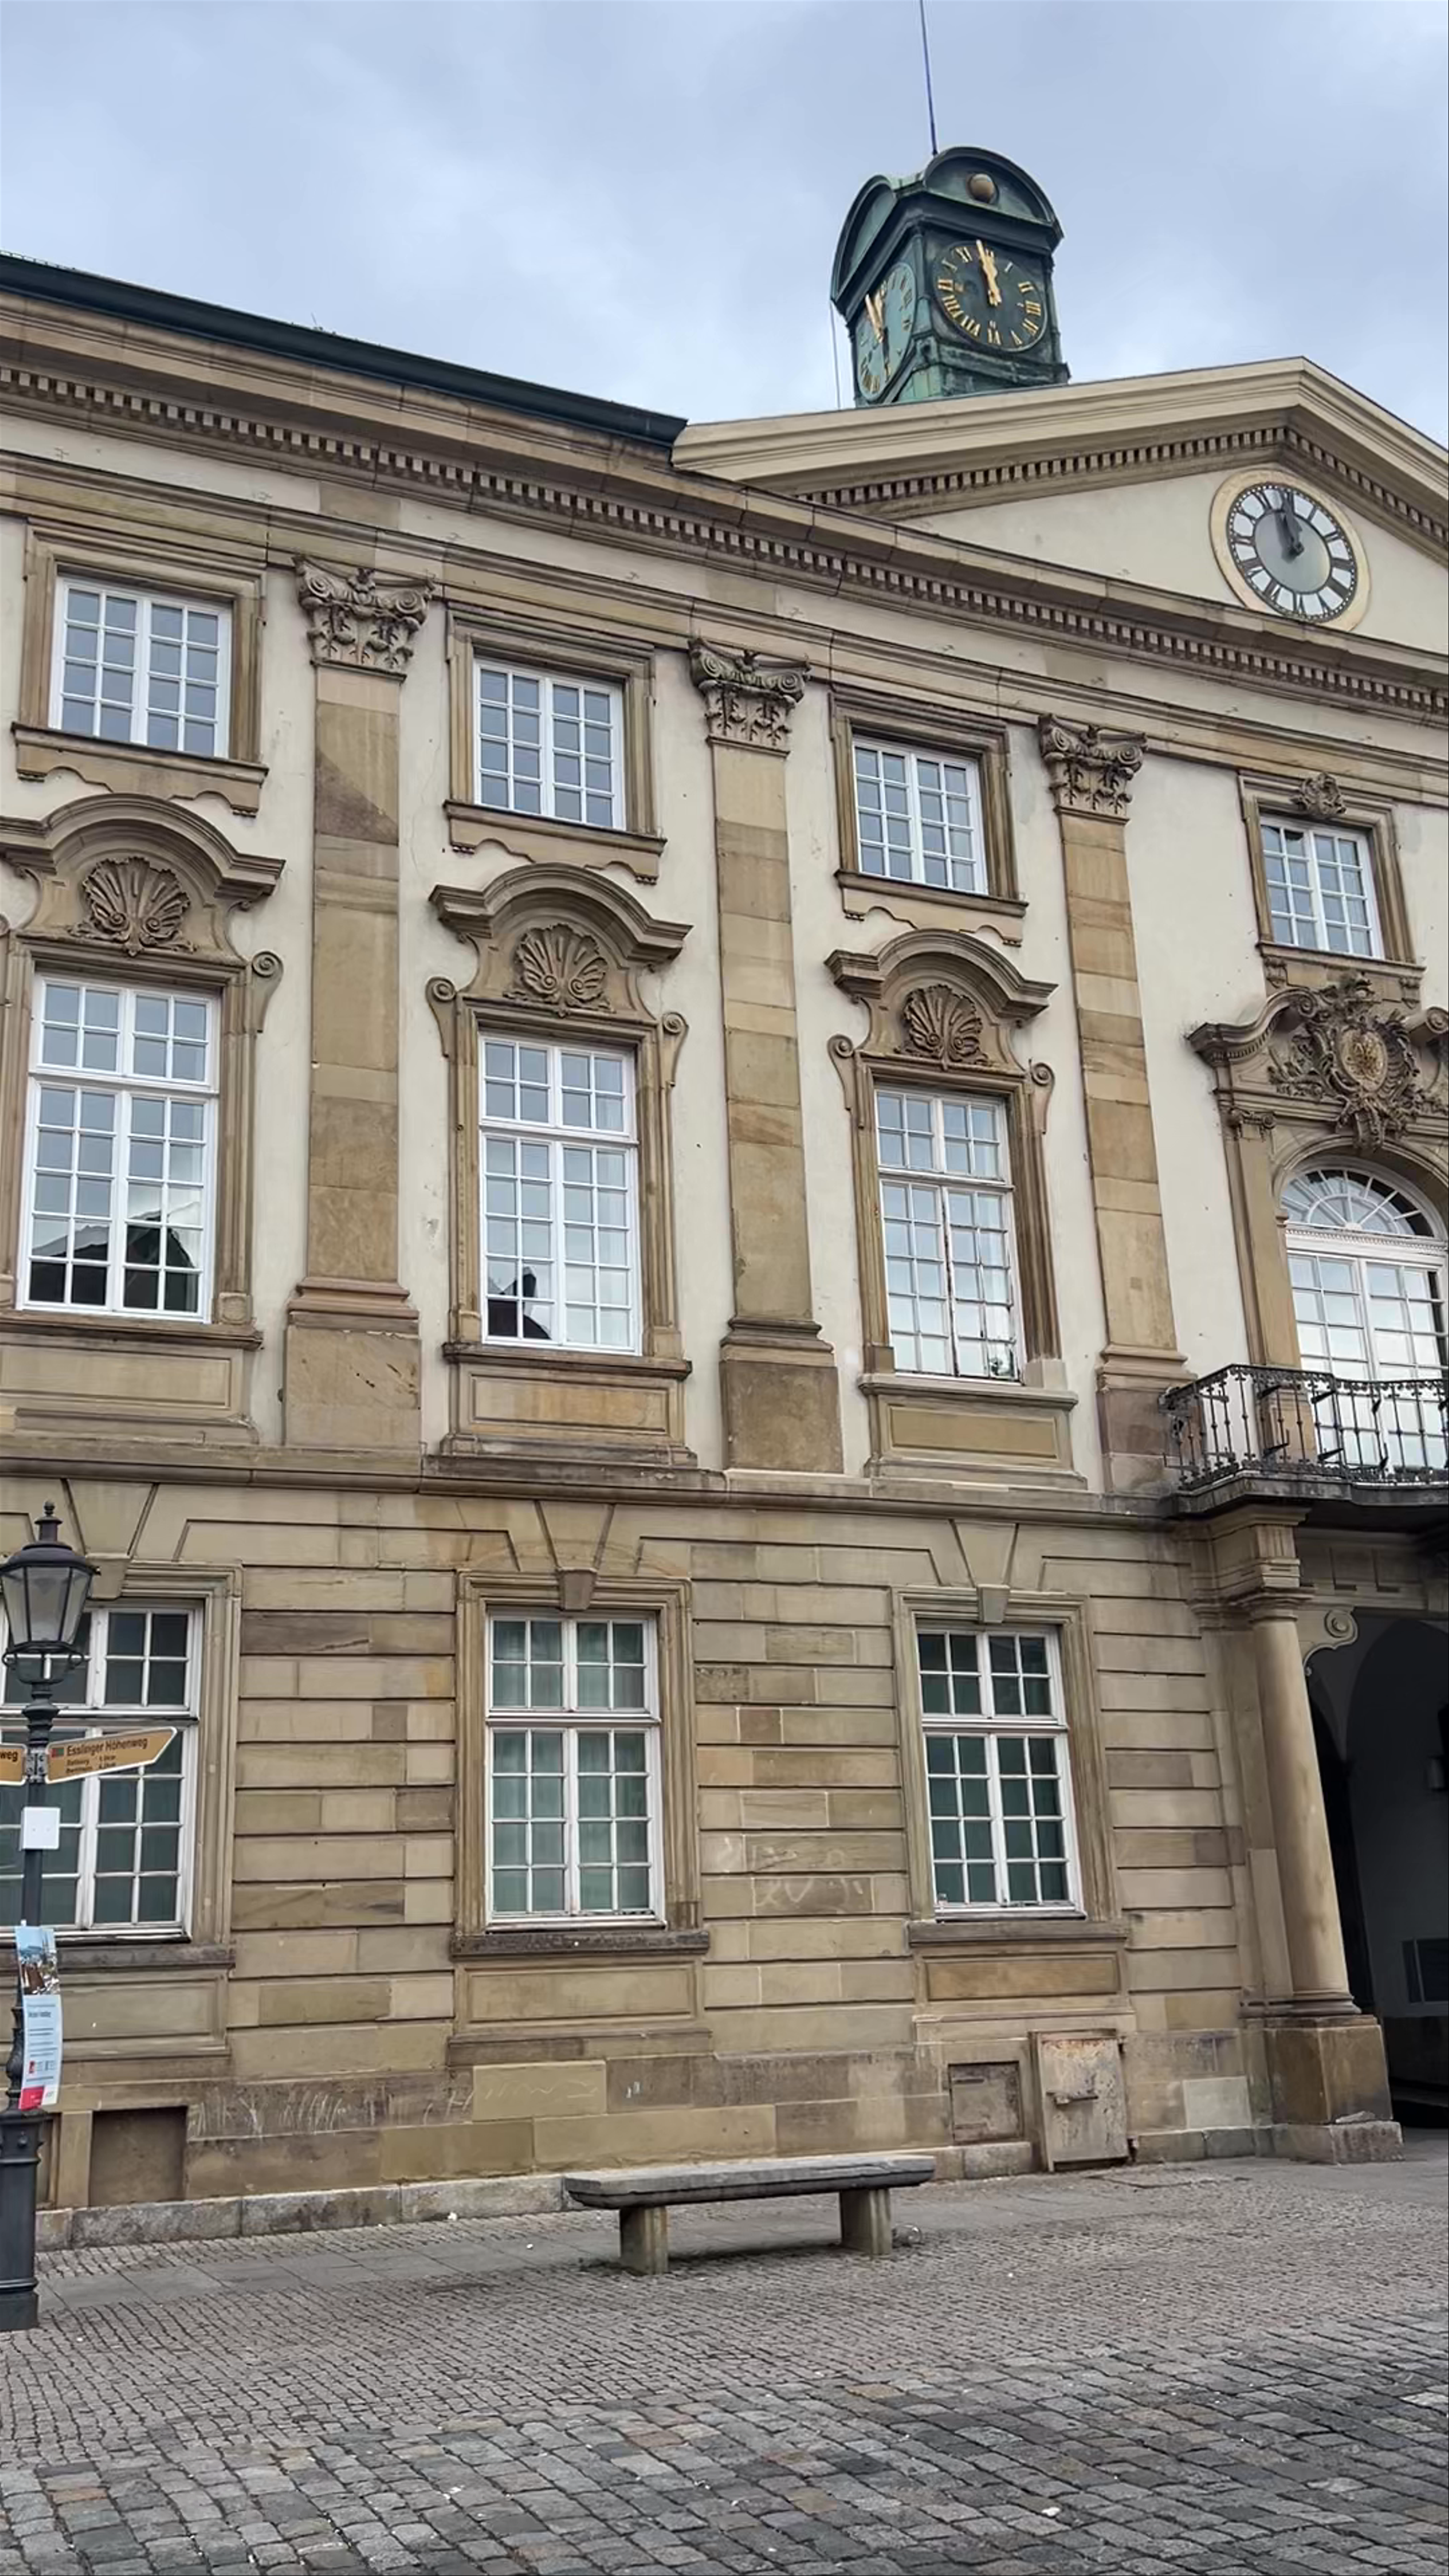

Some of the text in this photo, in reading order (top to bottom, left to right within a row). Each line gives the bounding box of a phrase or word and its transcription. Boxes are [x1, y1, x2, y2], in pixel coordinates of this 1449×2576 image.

[1017, 281, 1034, 294] II
[1024, 300, 1041, 317] III
[67, 1743, 104, 1756] Esslinger
